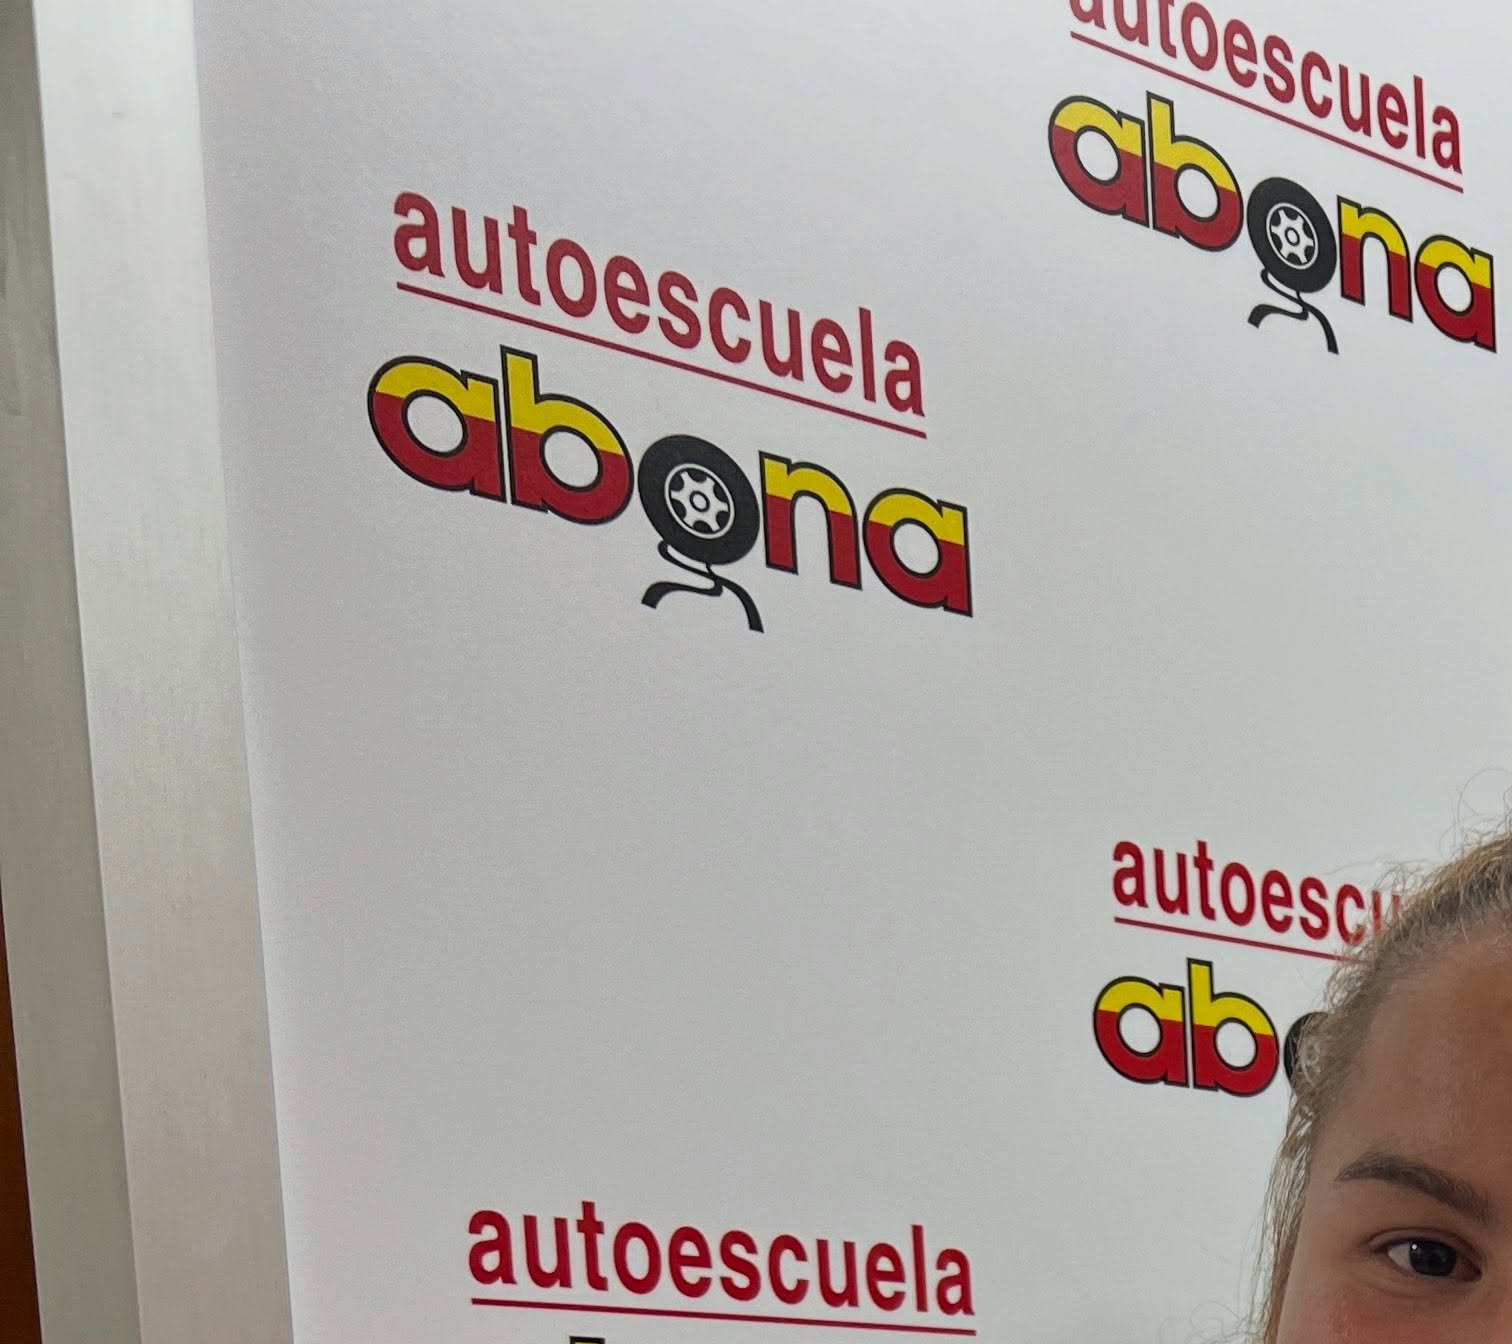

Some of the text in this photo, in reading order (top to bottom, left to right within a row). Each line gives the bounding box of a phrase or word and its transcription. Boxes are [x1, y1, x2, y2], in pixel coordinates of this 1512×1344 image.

[393, 191, 926, 418] autoescuela
[1048, 91, 1497, 354] abona
[366, 344, 974, 618] abona
[467, 1201, 975, 1316] autoescuela
